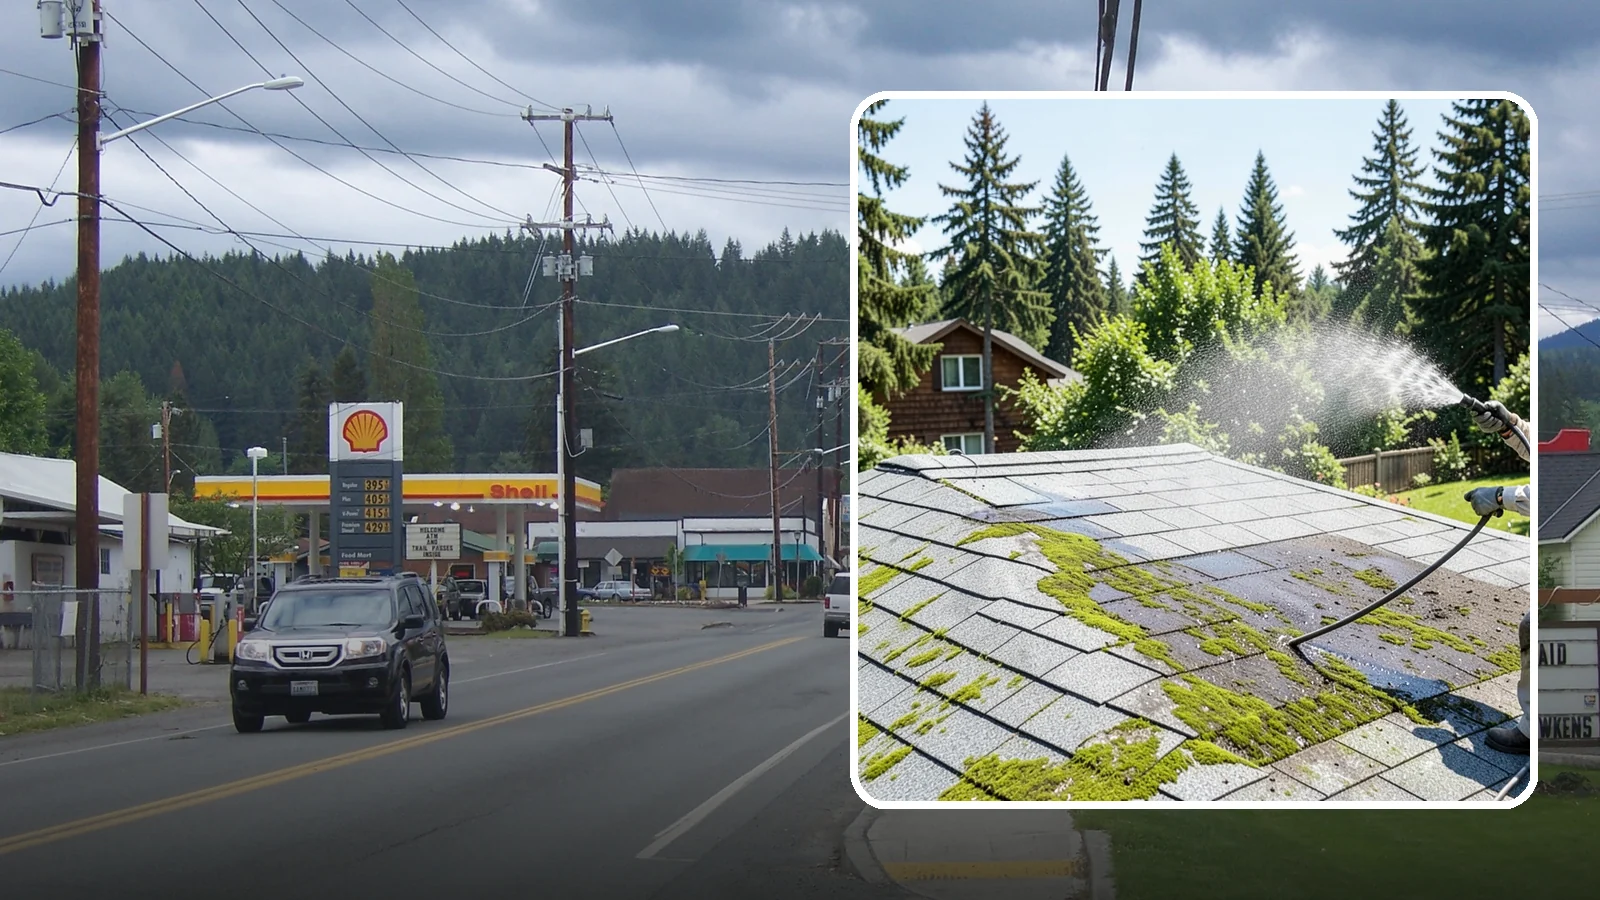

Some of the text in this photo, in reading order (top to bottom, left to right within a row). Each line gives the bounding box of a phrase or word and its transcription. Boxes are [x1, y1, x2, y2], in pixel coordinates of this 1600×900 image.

[366, 480, 384, 490] 395
[490, 484, 547, 499] Shell
[366, 494, 384, 504] 405
[366, 508, 384, 518] 415
[366, 522, 384, 532] 429
[1539, 642, 1567, 666] AID
[1538, 715, 1592, 739] WKENS
